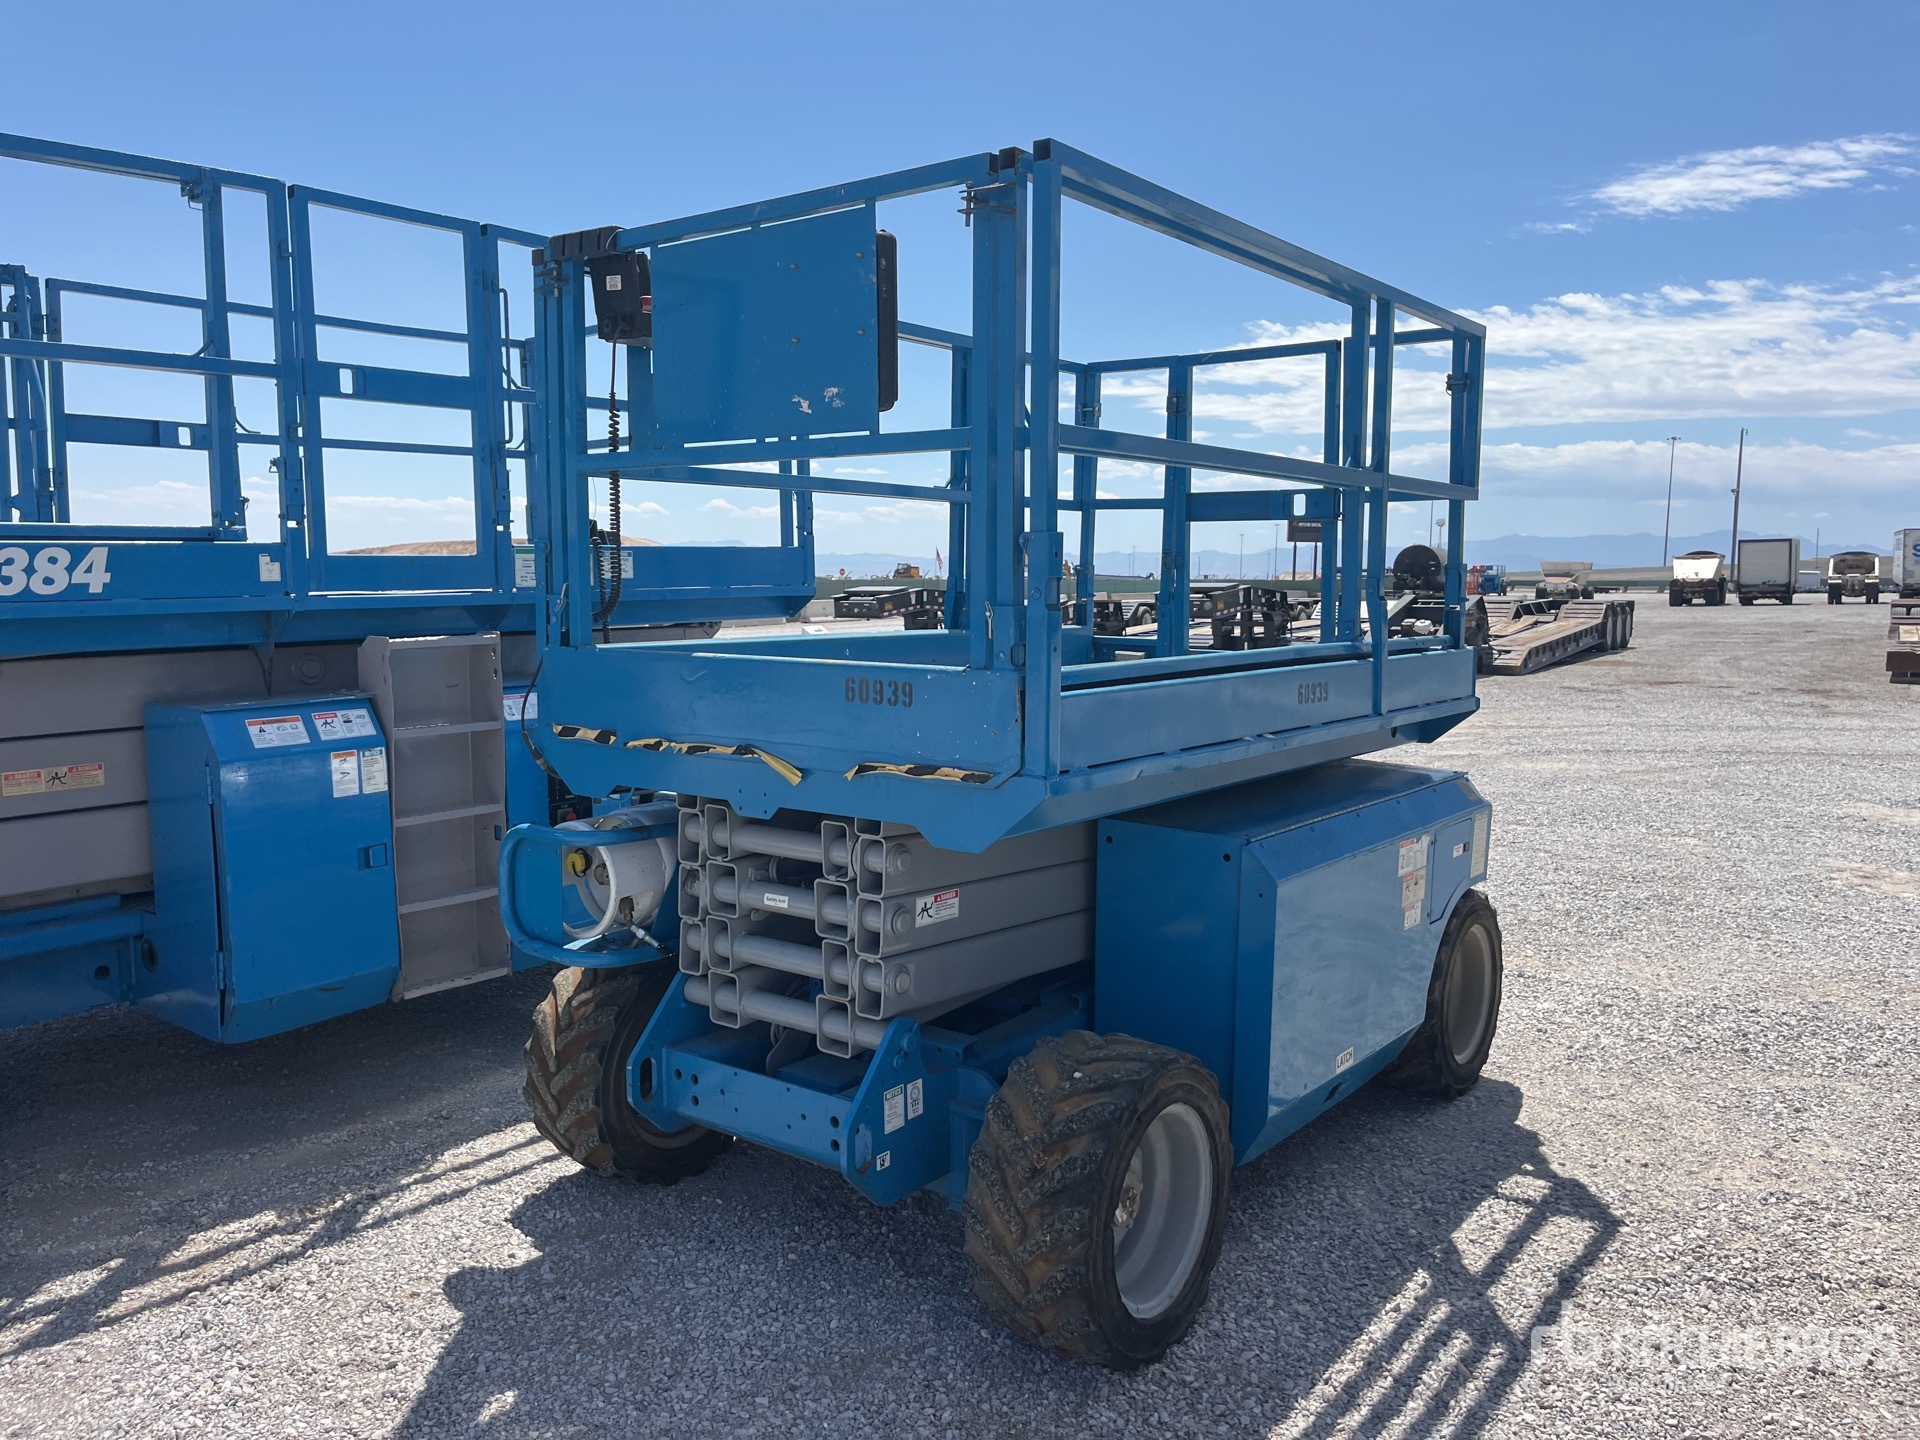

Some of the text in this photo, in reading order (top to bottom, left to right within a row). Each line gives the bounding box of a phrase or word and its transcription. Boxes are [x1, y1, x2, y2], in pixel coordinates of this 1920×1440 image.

[0, 546, 112, 596] 384
[844, 676, 914, 708] 60939
[1297, 682, 1329, 705] 60939
[15, 772, 38, 780] DANGER
[940, 891, 956, 900] DANGER
[1337, 1049, 1353, 1069] LATCH
[885, 1087, 902, 1100] NOTICE
